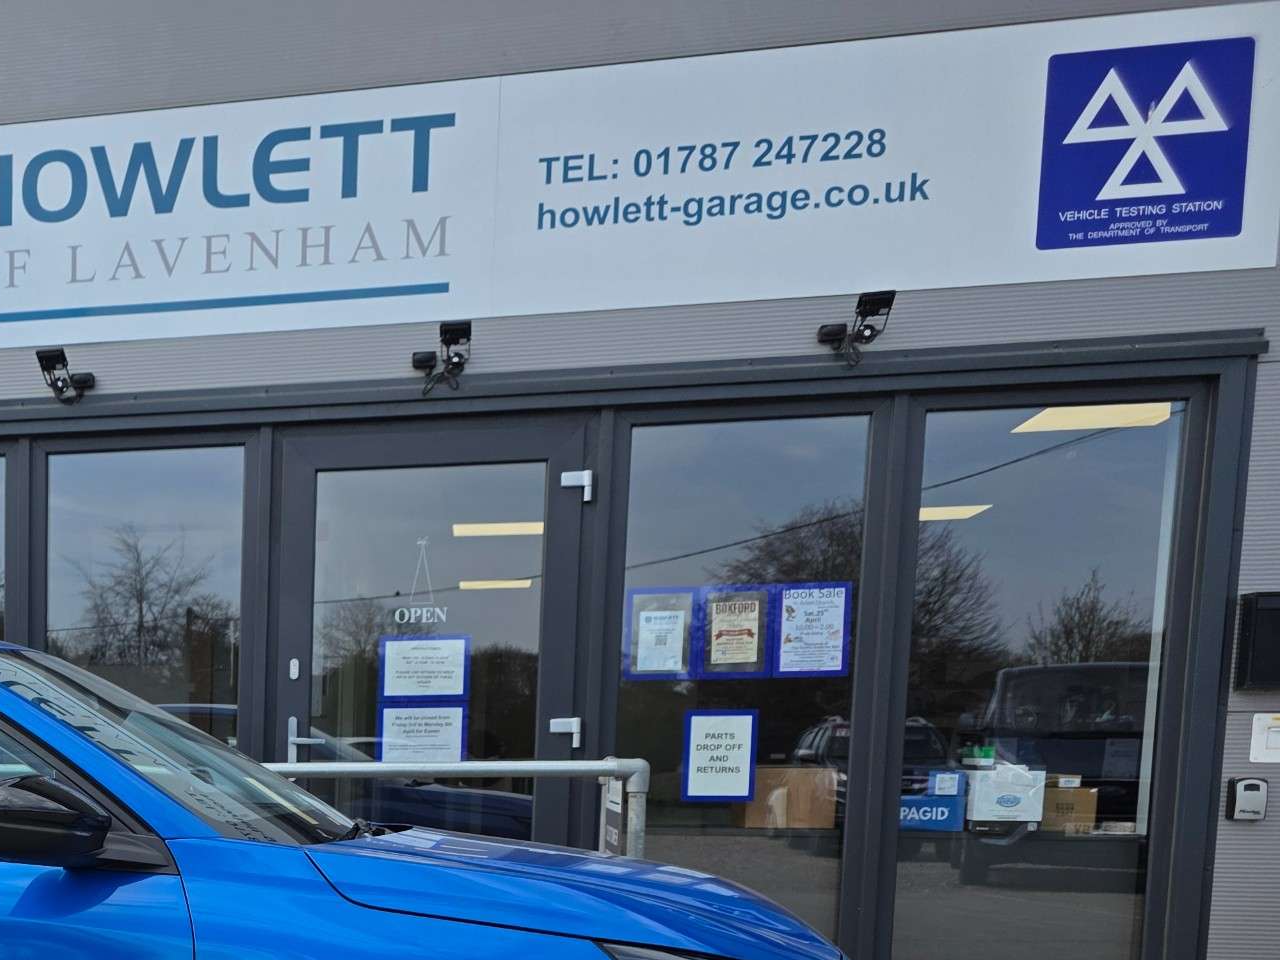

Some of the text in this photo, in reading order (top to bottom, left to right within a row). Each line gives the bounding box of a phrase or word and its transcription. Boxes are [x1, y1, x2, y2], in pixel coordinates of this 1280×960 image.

[538, 127, 888, 185] TEL: 01787 247228
[536, 172, 931, 232] howlett-garage.co.uk
[1058, 200, 1223, 222] VEHICLE TESTING STATION
[1068, 223, 1209, 241] THE DEPARTMENT OF TRANSPORT
[1109, 219, 1169, 230] APPROVED BY
[66, 215, 453, 285] LAVENHAM
[784, 588, 844, 600] Book Sale
[394, 607, 448, 624] OPEN
[704, 732, 736, 740] PARTS
[696, 743, 744, 752] DROP OFF
[708, 754, 729, 762] AND
[696, 766, 741, 774] RETURNS
[899, 806, 949, 821] PAGID
